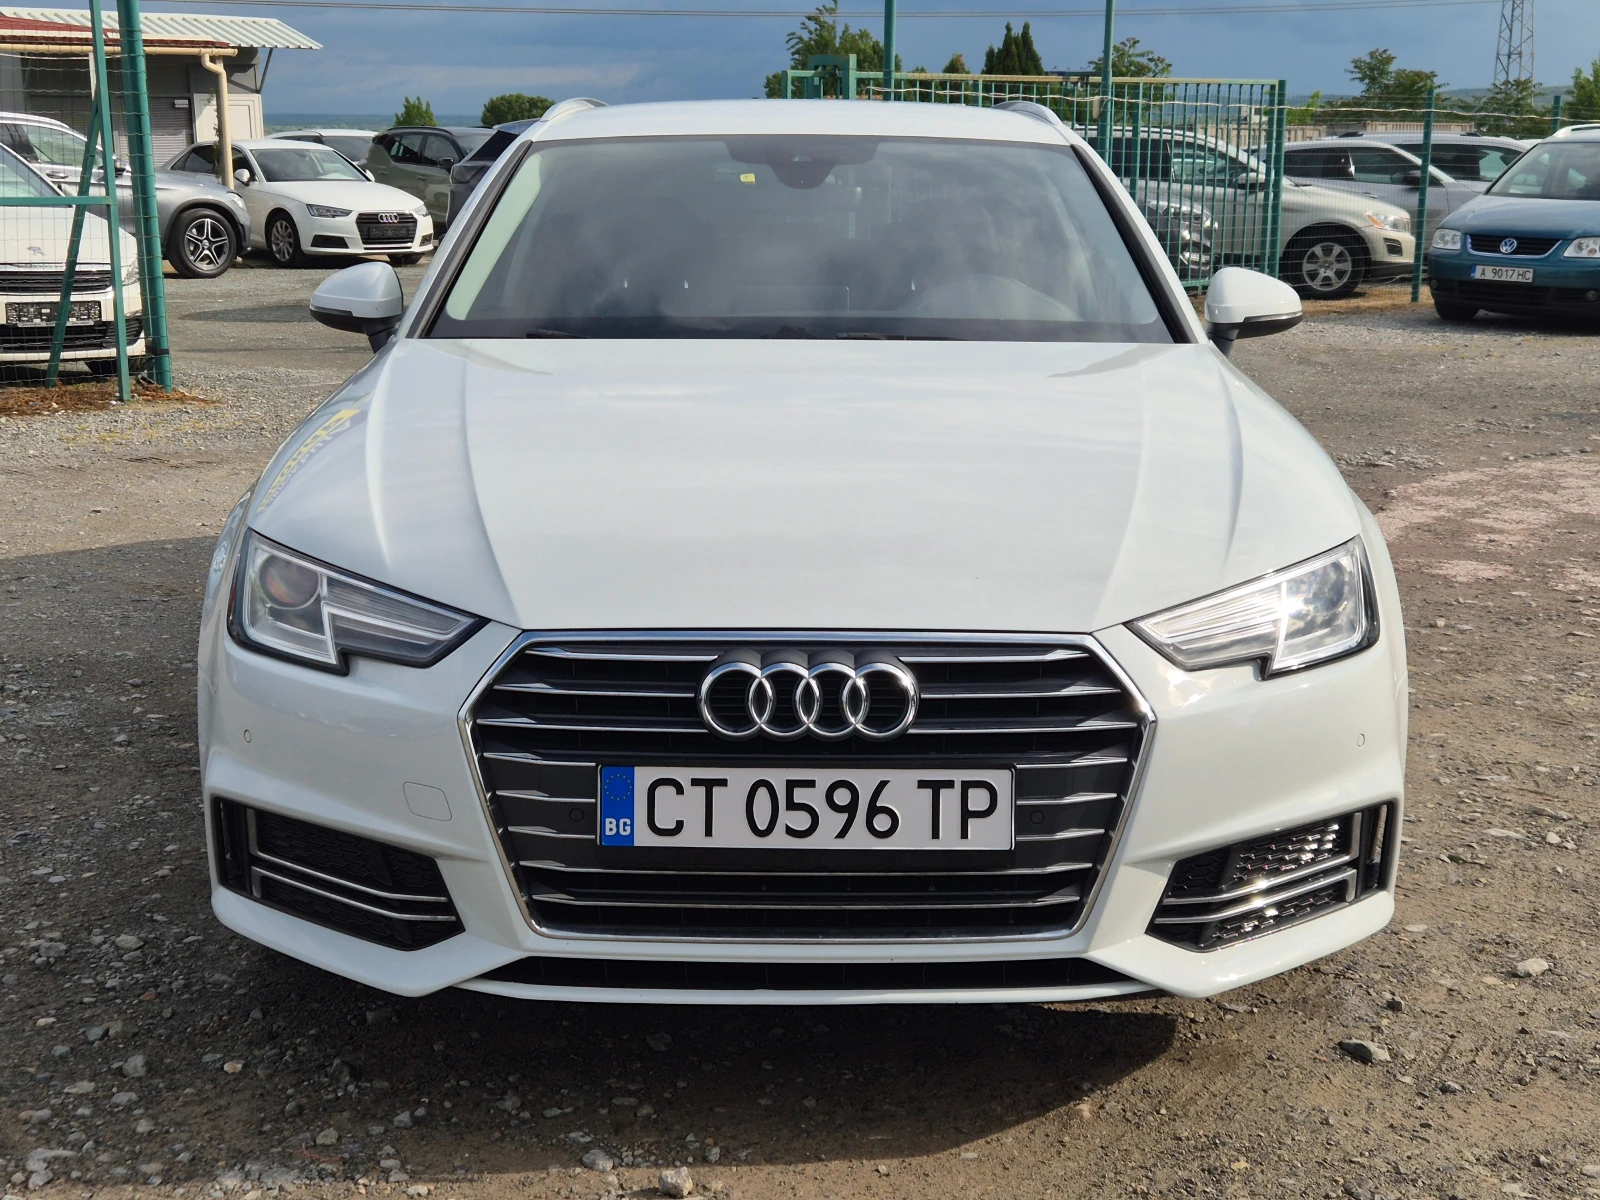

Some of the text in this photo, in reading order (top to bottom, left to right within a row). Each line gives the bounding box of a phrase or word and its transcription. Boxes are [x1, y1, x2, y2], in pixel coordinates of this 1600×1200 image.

[1491, 268, 1516, 280] 9017
[1517, 269, 1531, 281] HC
[646, 777, 999, 840] CT 0596 TP
[604, 817, 632, 837] BG
